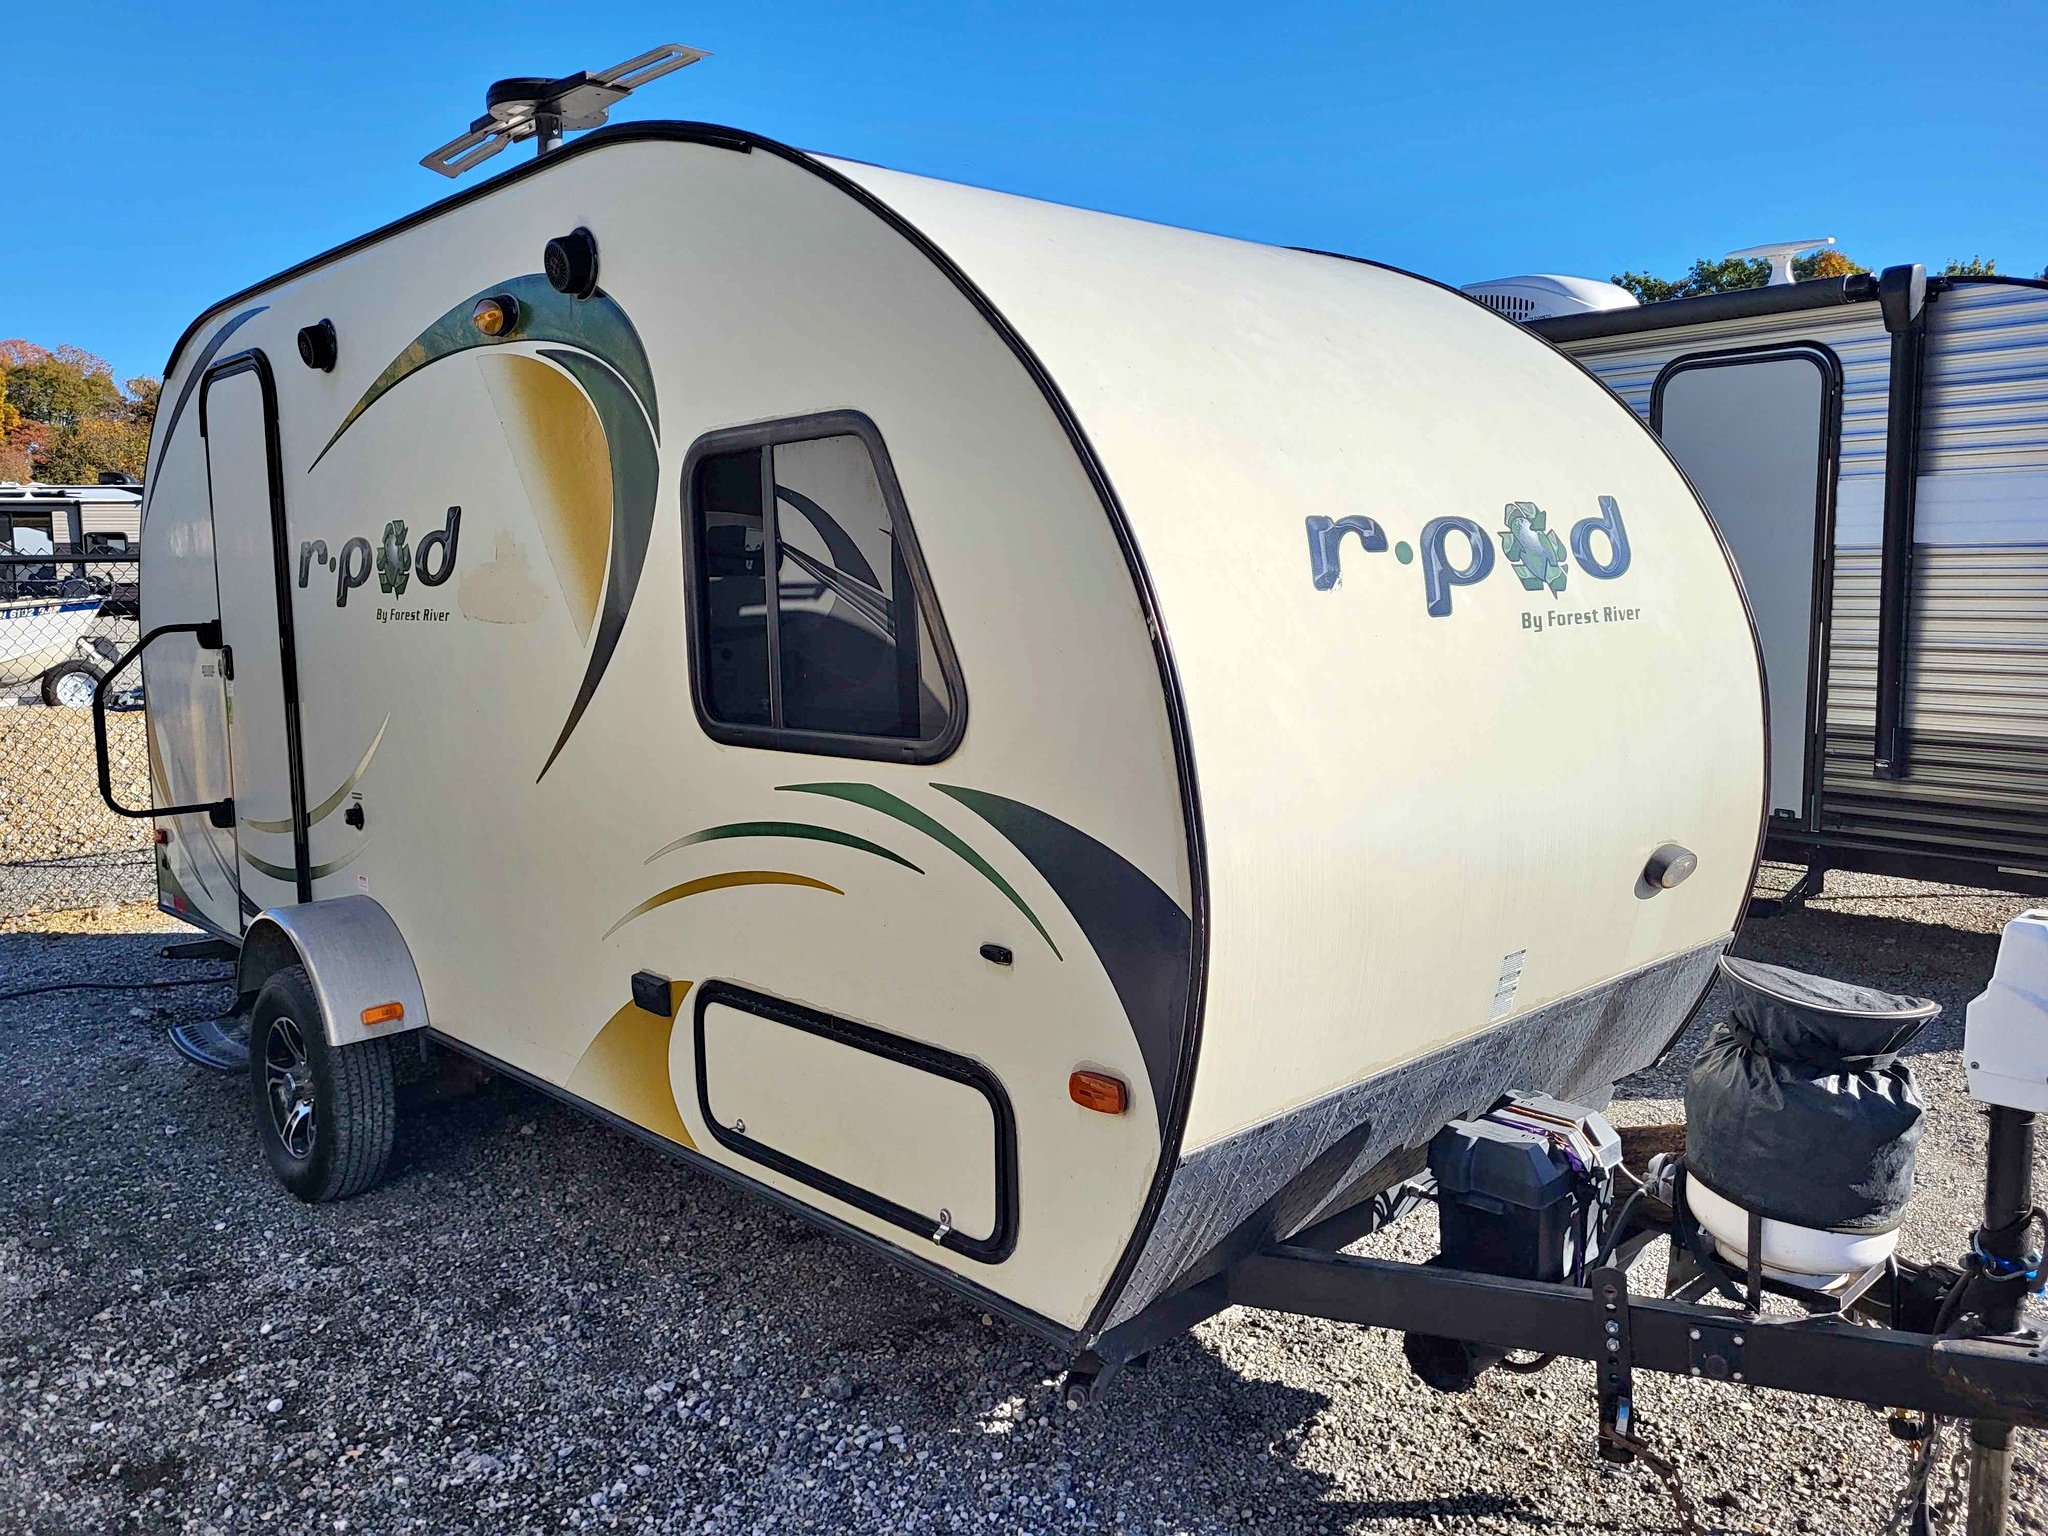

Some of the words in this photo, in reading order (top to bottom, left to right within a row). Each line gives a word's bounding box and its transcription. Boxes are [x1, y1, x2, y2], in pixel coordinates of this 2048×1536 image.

[376, 608, 388, 623] By
[390, 609, 421, 621] Forest
[423, 609, 450, 622] River
[1521, 610, 1543, 632] By
[1548, 608, 1600, 627] Forest
[1604, 606, 1641, 622] River
